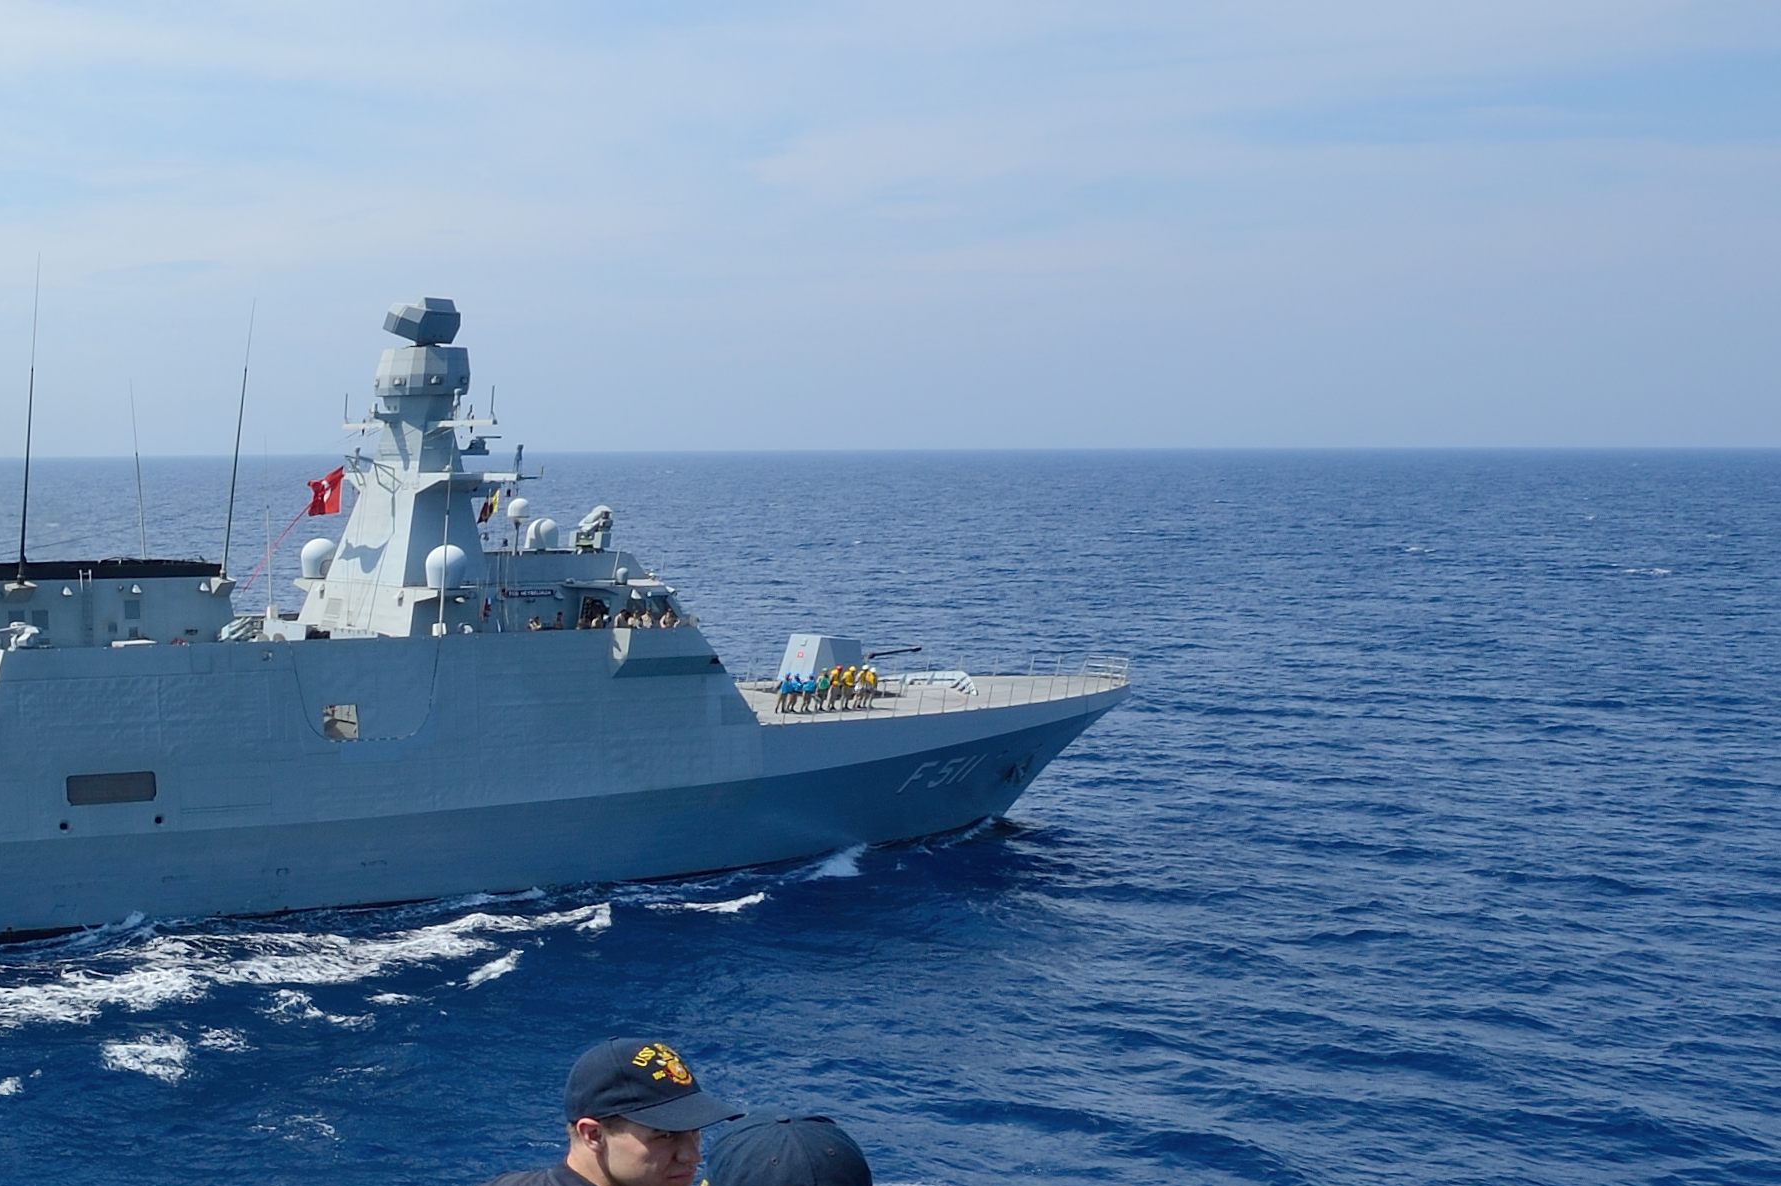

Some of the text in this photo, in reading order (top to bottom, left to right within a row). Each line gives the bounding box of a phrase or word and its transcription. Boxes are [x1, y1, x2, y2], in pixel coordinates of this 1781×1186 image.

[896, 753, 989, 793] F 511
[631, 1046, 656, 1067] USS
